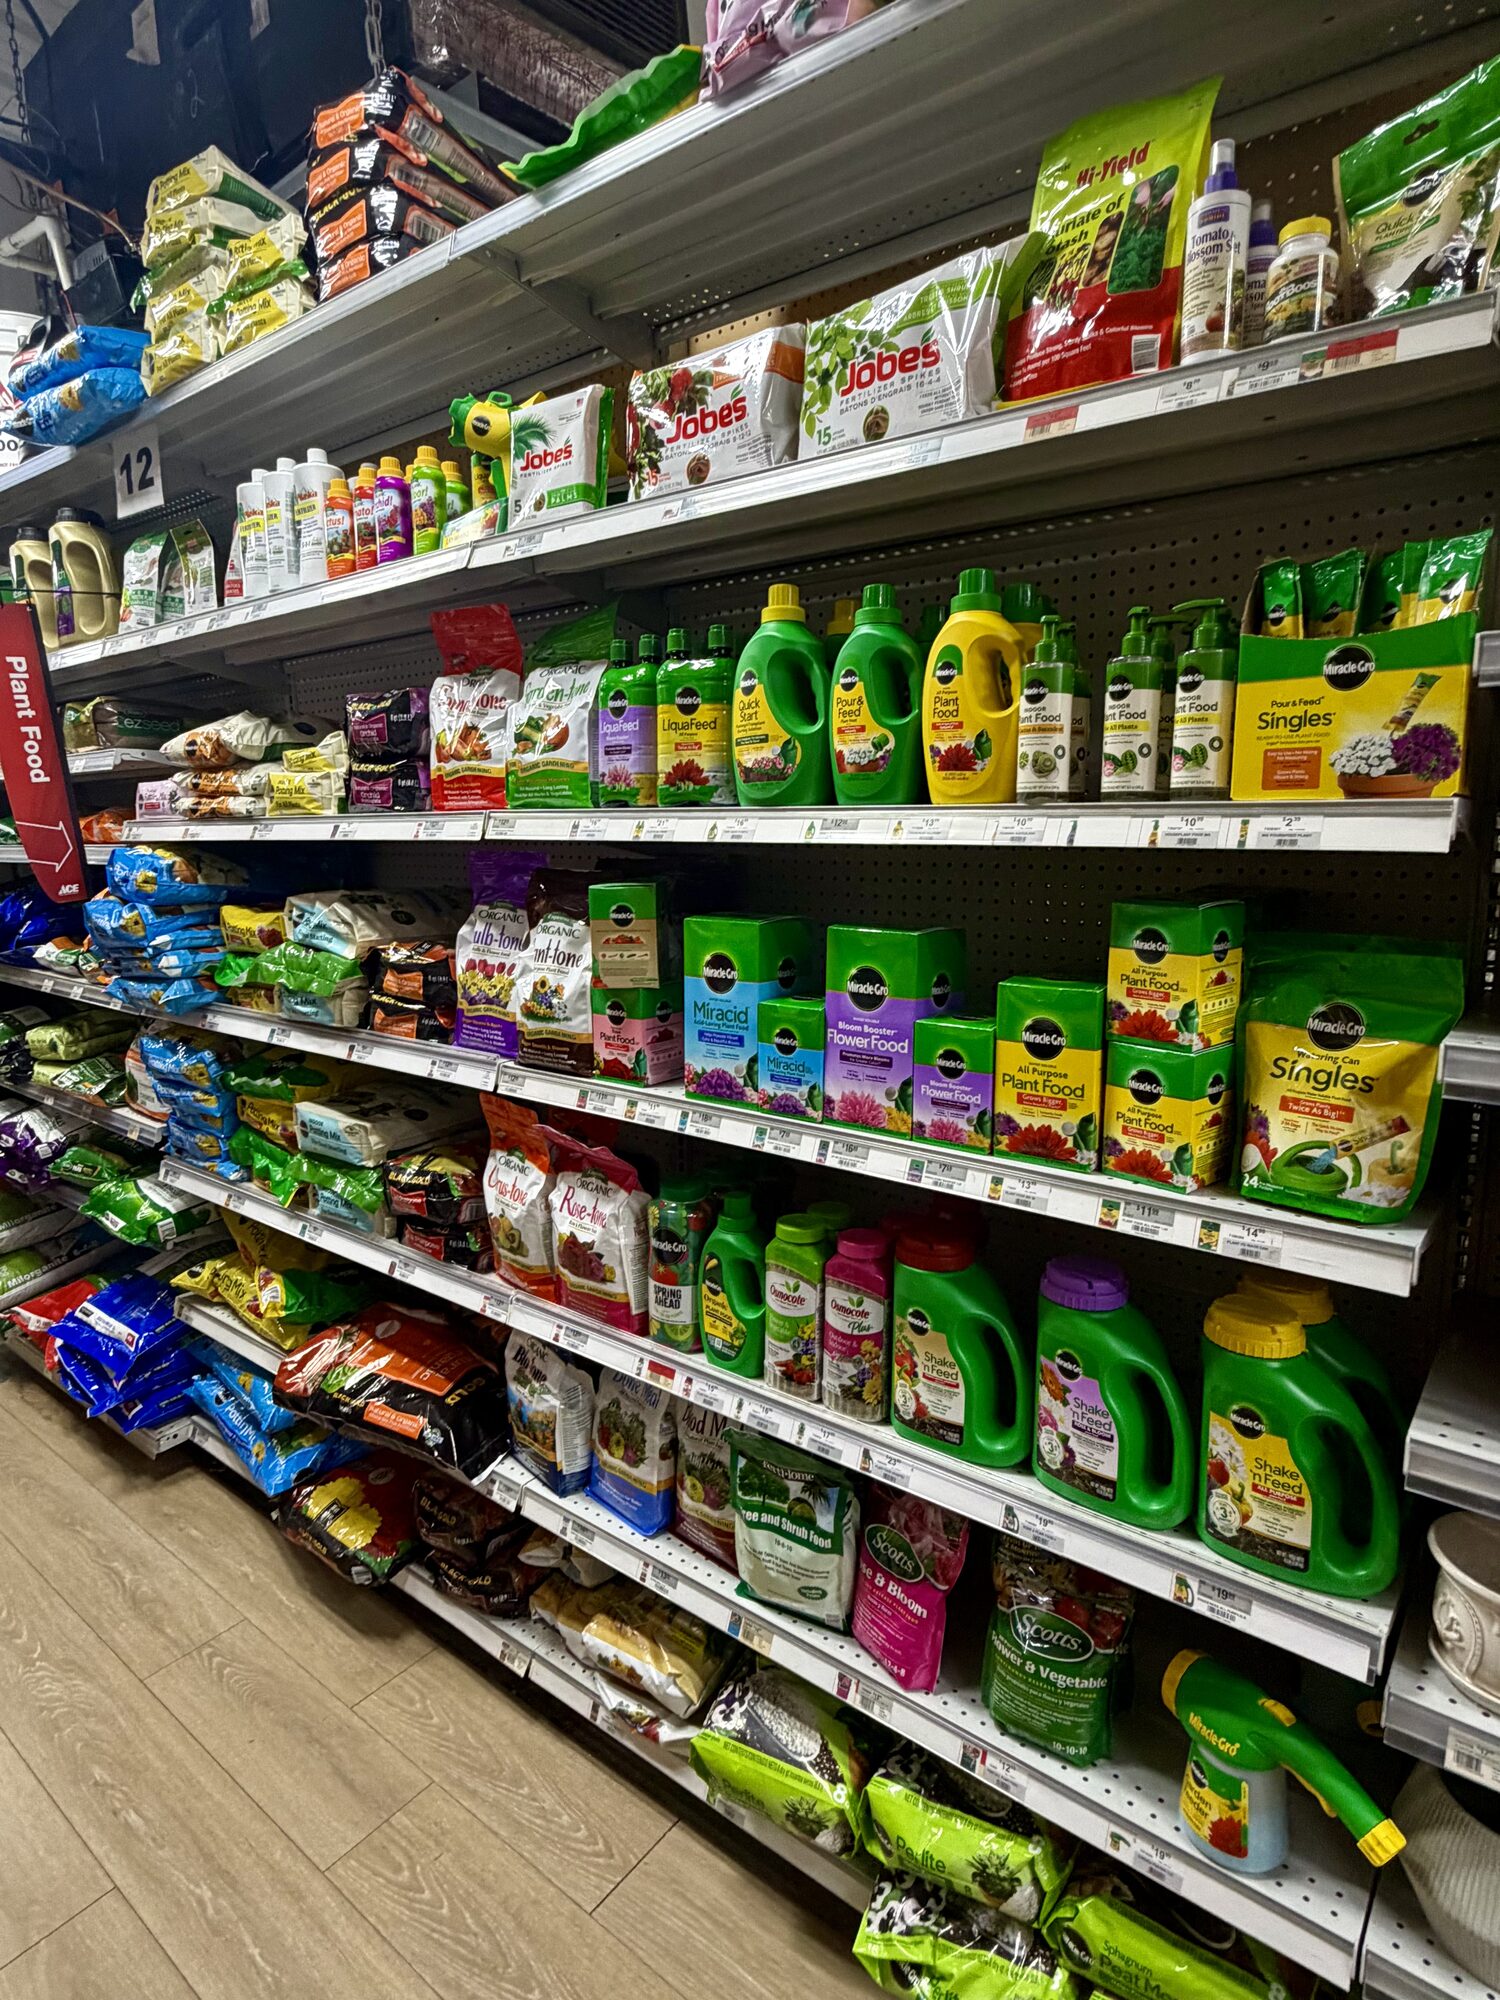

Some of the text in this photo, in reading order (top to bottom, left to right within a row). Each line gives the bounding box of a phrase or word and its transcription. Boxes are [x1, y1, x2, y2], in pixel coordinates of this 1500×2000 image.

[1076, 142, 1151, 187] Hi-Yield
[1052, 193, 1126, 238] uriate of
[1192, 227, 1229, 250] Tomato
[840, 367, 942, 406] FERTILIZER SPIKES
[720, 422, 750, 438] SPIKES
[816, 426, 832, 446] 15
[119, 446, 155, 495] 12
[514, 500, 522, 513] 5
[738, 697, 761, 712] Quick
[933, 695, 960, 707] Plant
[1188, 702, 1218, 713] Food
[1271, 700, 1291, 709] Pour
[1298, 697, 1321, 707] Feed
[5, 656, 51, 784] Plant Food
[739, 709, 759, 722] Start
[837, 707, 862, 719] Feed
[932, 706, 960, 719] Food
[1034, 712, 1062, 723] Food
[1118, 709, 1147, 720] Food
[1257, 709, 1333, 733] Singles
[600, 718, 640, 735] LiquaFeed
[662, 717, 718, 735] LiquaFeed
[58, 883, 80, 896] ACE
[478, 908, 525, 925] ORGANIC
[1120, 974, 1180, 992] Plant Food
[1131, 968, 1168, 980] All Purpose
[846, 980, 890, 996] Miracle-Gro
[693, 1000, 749, 1025] Miracid
[838, 1020, 897, 1037] Bloom Booster
[1306, 1017, 1366, 1038] Miracle-Gro
[616, 1033, 635, 1045] Food
[827, 1028, 909, 1054] Flower Food
[1021, 1031, 1067, 1046] Miracle-Gro
[767, 1055, 806, 1073] Miracid
[1340, 1055, 1361, 1066] Can
[1017, 1065, 1069, 1080] All Purpose
[1269, 1056, 1376, 1094] Singles
[920, 1084, 981, 1104] Flower Food
[929, 1079, 973, 1092] Bloom Booster
[1001, 1073, 1085, 1099] Plant Food
[1127, 1107, 1163, 1121] All Purpose
[1288, 1103, 1312, 1114] Twice
[1312, 1106, 1323, 1115] As
[1116, 1112, 1174, 1134] Plant Food
[327, 1130, 342, 1141] Mix
[576, 1178, 615, 1199] ORGANIC
[1243, 1173, 1260, 1188] 24
[559, 1185, 608, 1229] Rose-tone
[6, 1254, 69, 1290] Milorganite
[654, 1297, 681, 1310] AHEAD
[770, 1284, 806, 1306] Osmocote
[830, 1298, 870, 1320] Osmocote
[847, 1318, 874, 1334] Plus
[923, 1350, 957, 1370] Shake
[930, 1363, 959, 1382] Feed
[1073, 1397, 1110, 1420] Shake
[1081, 1411, 1114, 1433] Feed
[1254, 1456, 1300, 1481] Shake
[1263, 1474, 1303, 1496] Feed
[1221, 1506, 1229, 1519] 3
[761, 1513, 781, 1528] and
[781, 1517, 808, 1541] Shrub
[808, 1530, 833, 1550] Food
[872, 1531, 915, 1575] Scotts
[874, 1573, 928, 1620] & Bloom
[1018, 1613, 1082, 1651] Scotts
[1024, 1661, 1037, 1674] &
[1038, 1664, 1108, 1690] Vegetable
[1188, 1710, 1240, 1758] Miracle-Gro
[1052, 1741, 1088, 1756] 10-10-10
[895, 1834, 947, 1875] Perlite
[1103, 1939, 1153, 1978] Sphagnum
[1100, 1953, 1141, 1988] Peat
